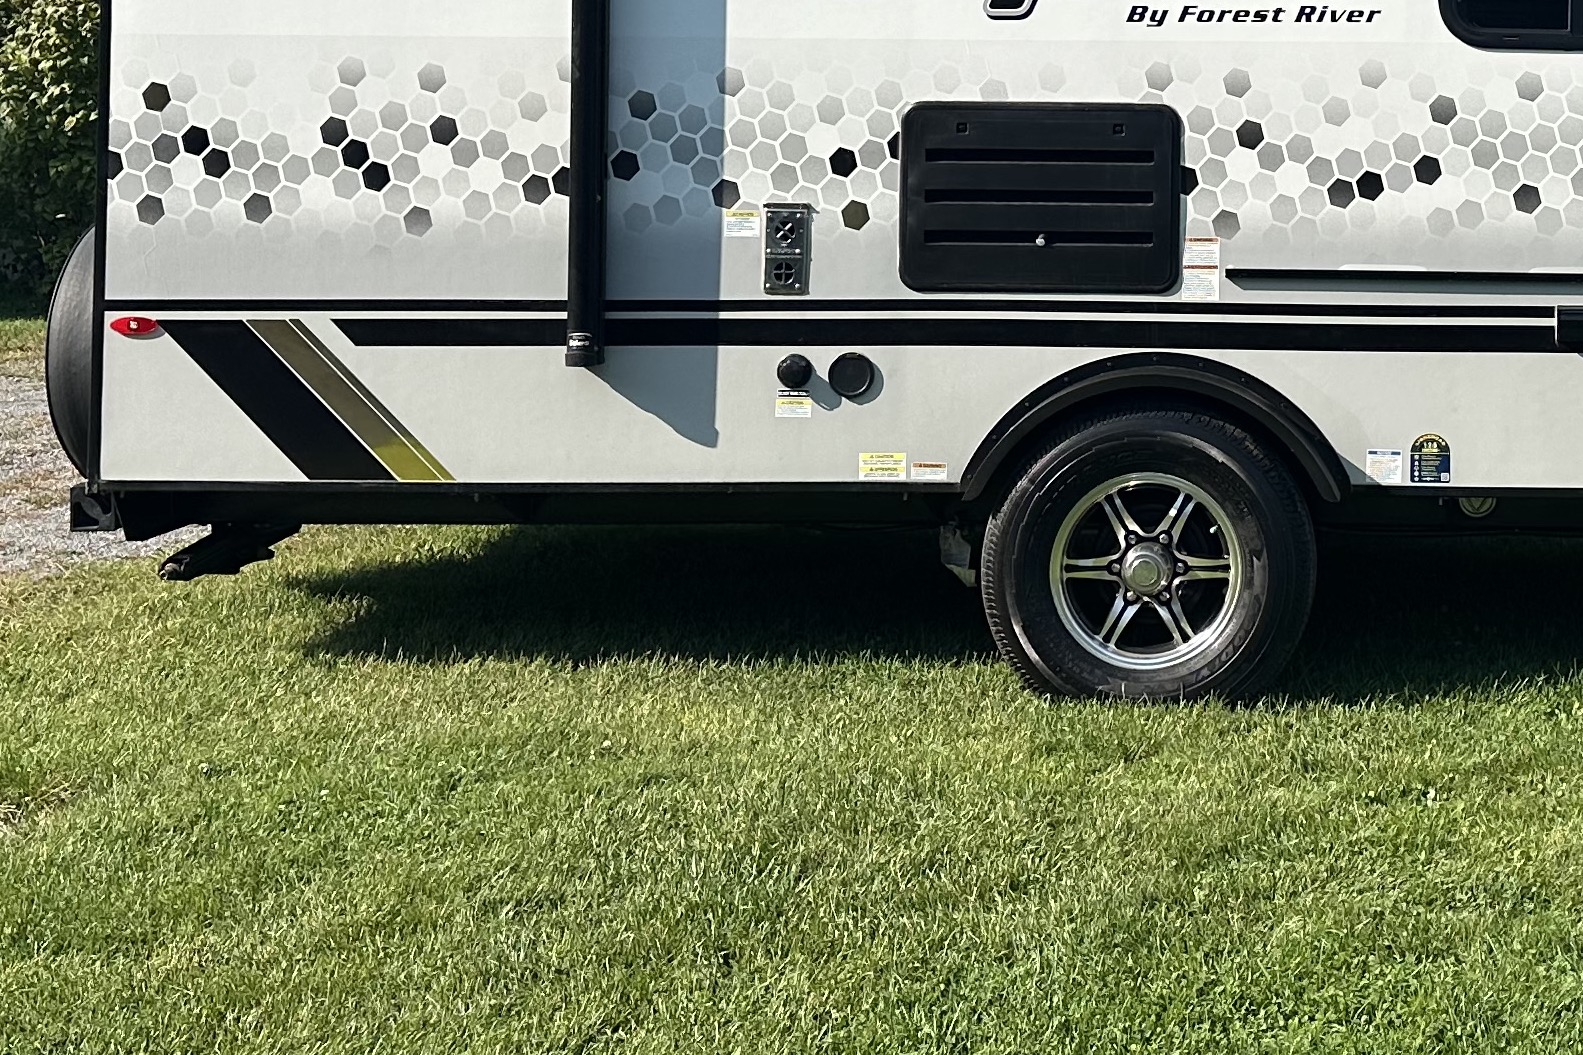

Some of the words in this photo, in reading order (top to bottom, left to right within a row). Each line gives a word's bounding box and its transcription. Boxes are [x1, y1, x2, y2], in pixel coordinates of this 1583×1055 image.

[1125, 5, 1169, 28] By
[1177, 5, 1286, 23] Forest
[1293, 5, 1382, 23] River
